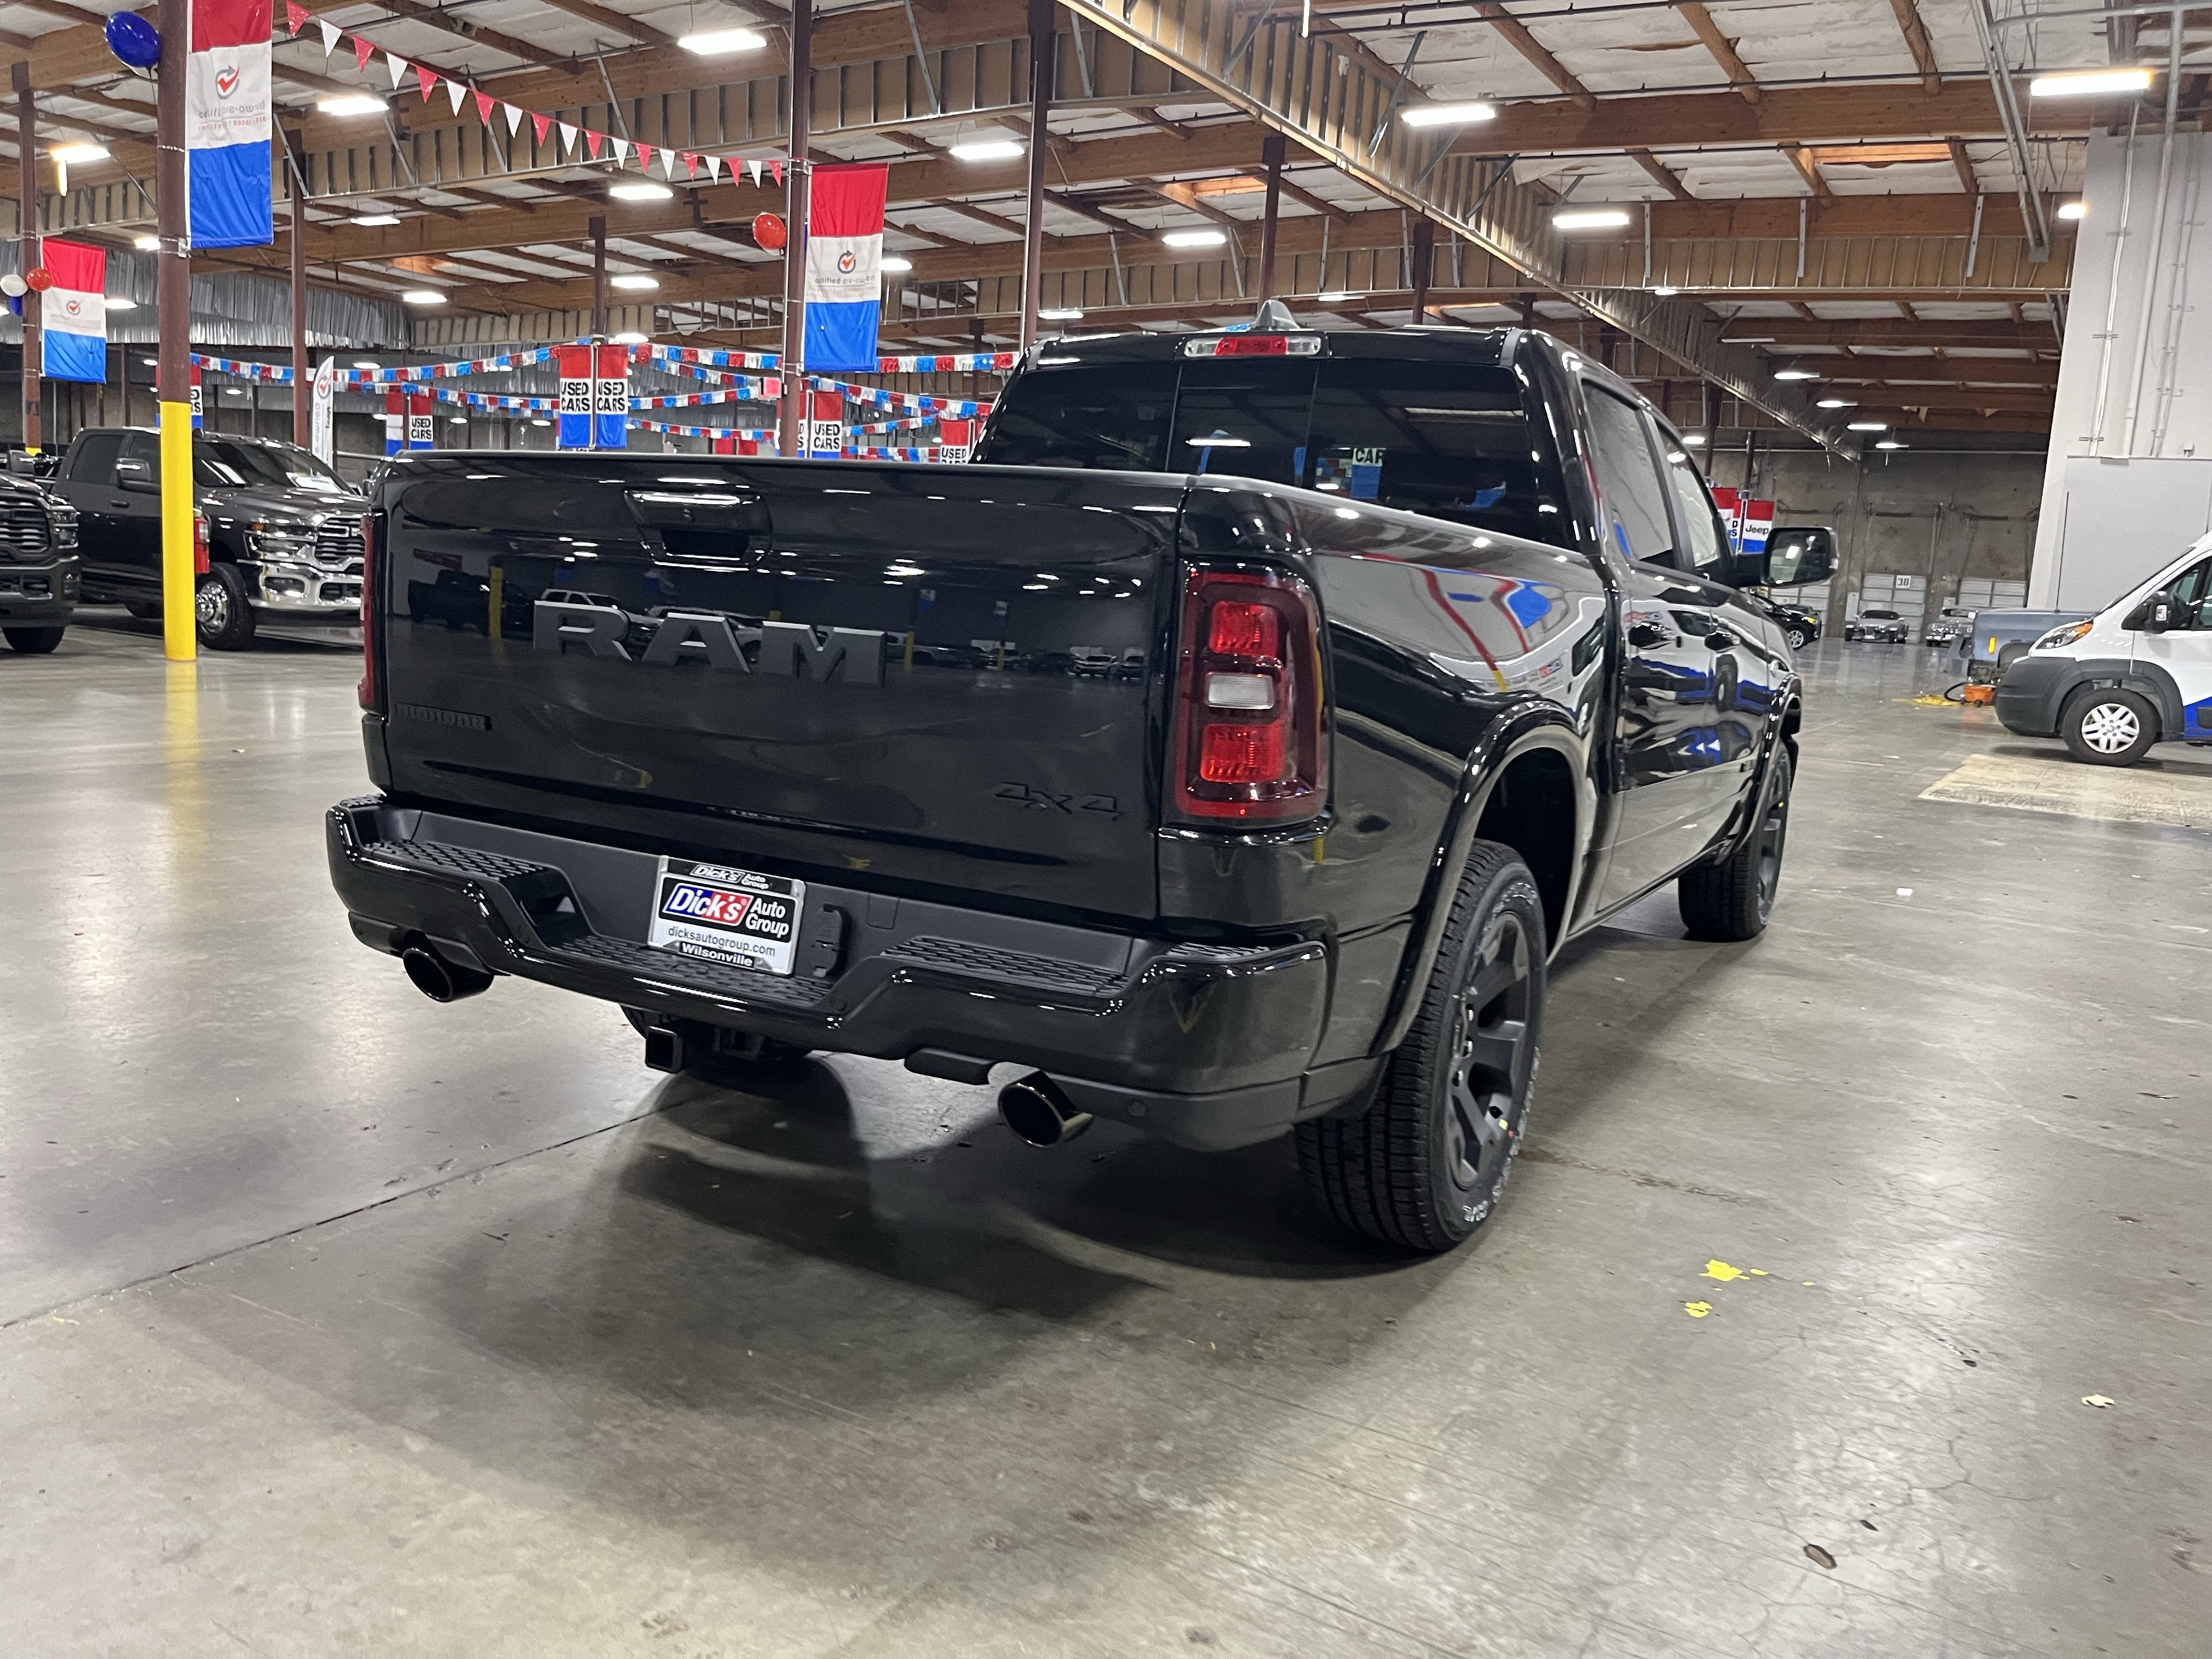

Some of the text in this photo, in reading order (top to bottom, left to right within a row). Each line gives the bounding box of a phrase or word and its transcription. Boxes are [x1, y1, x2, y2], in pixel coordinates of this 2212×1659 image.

[561, 381, 589, 396] USED
[598, 381, 625, 396] USED
[561, 397, 590, 411] CARS
[597, 397, 625, 412] CARS
[411, 417, 431, 428] USED
[815, 423, 840, 436] USED
[941, 447, 967, 459] USED
[1745, 524, 1769, 535] Jeep
[533, 600, 887, 688] RAM
[741, 879, 769, 890] Group
[744, 873, 766, 883] Auto
[751, 898, 786, 918] Auto
[746, 913, 789, 938] Group
[668, 926, 776, 956] dicksautogroup.com
[681, 942, 753, 967] Wilsonville
